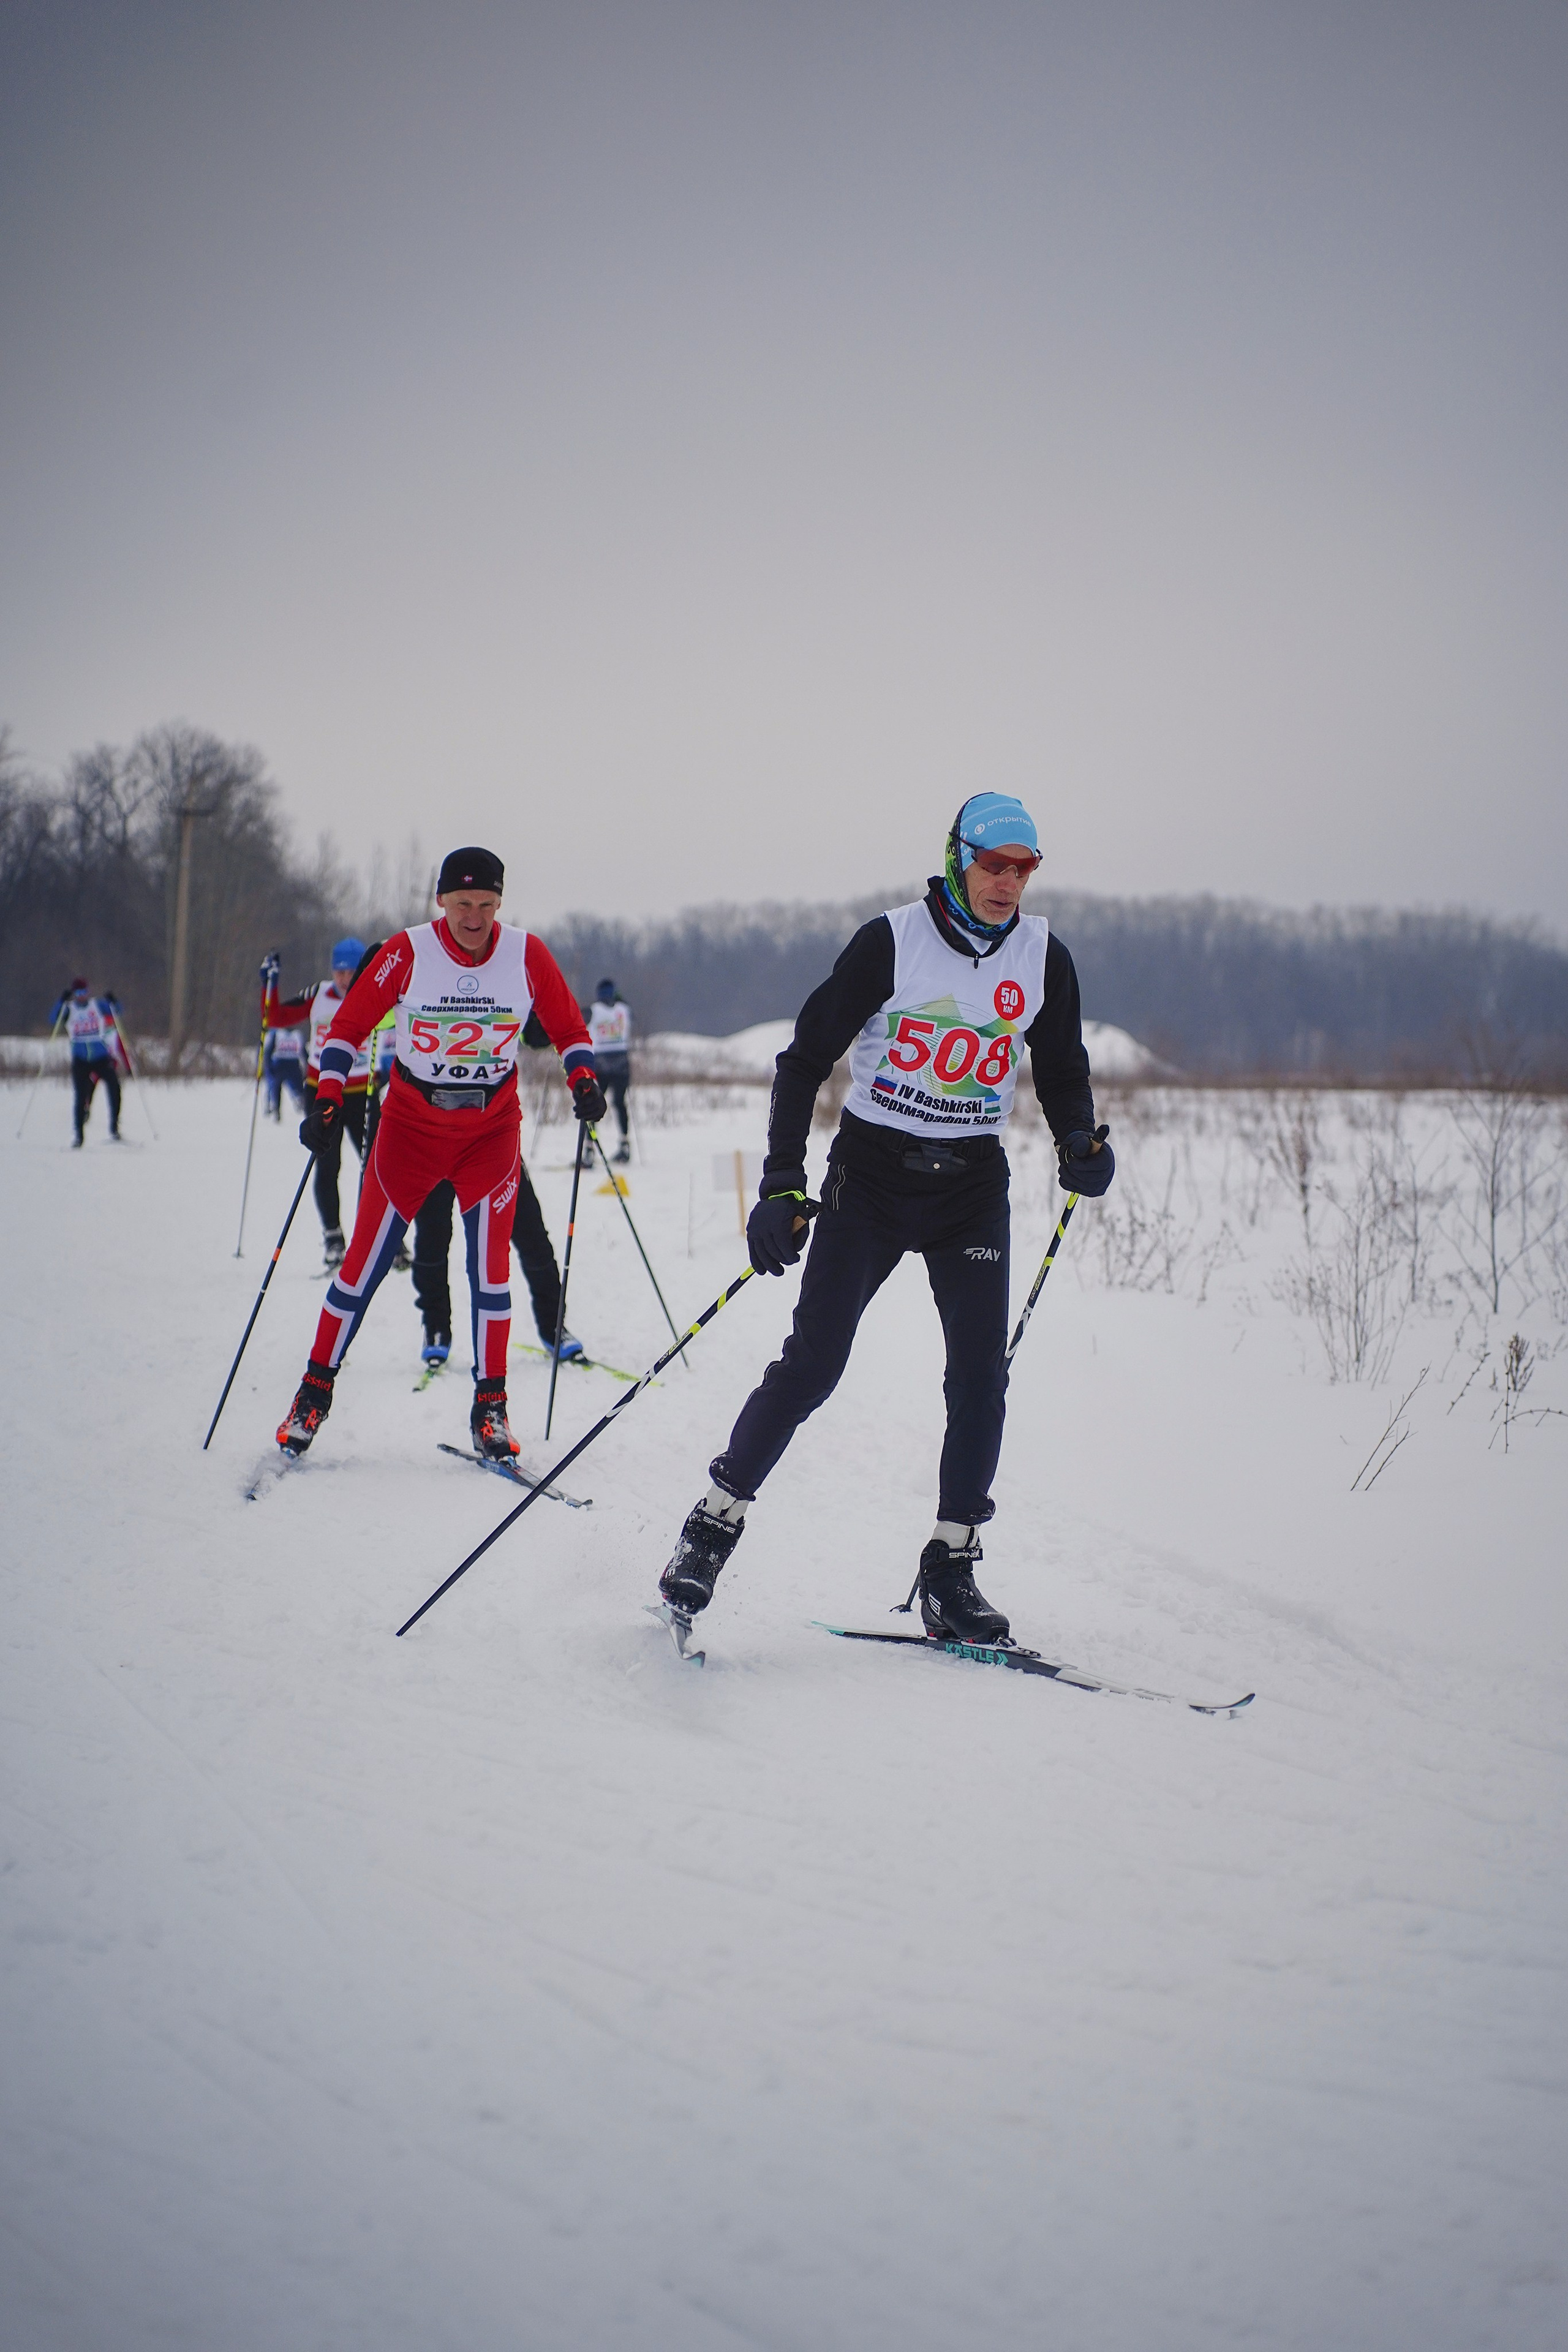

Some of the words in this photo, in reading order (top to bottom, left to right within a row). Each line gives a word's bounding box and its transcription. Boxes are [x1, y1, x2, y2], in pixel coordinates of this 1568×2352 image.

[1001, 987, 1018, 1006] 50
[411, 1019, 521, 1056] 527
[888, 1017, 1012, 1087] 508
[431, 1063, 489, 1080] УФА
[897, 1084, 916, 1100] IV
[963, 1247, 1001, 1262] RAY
[703, 1516, 736, 1534] SPINE
